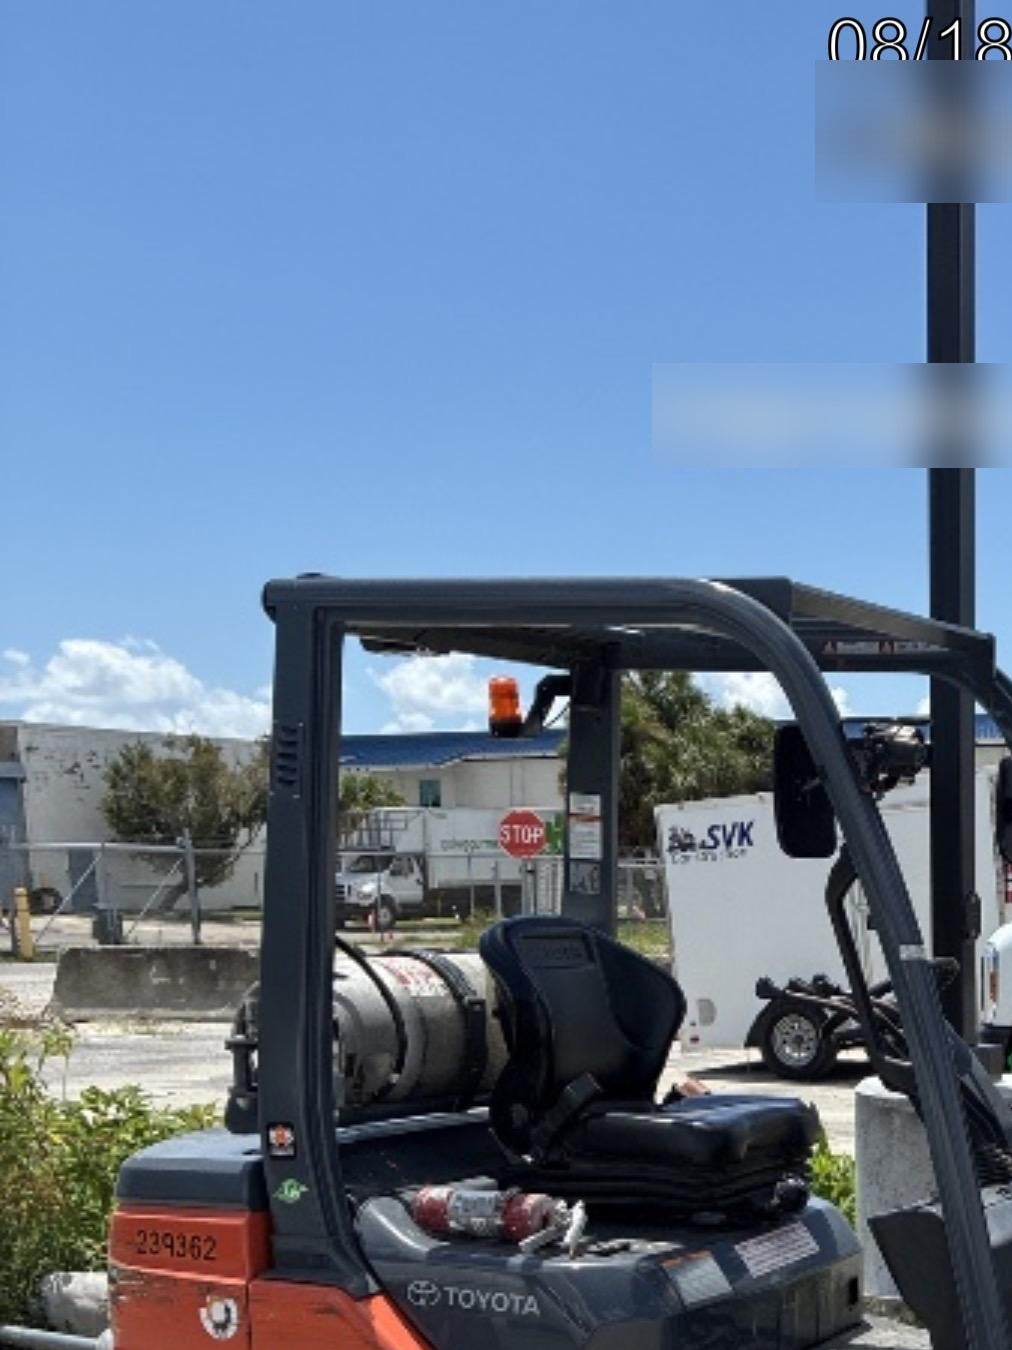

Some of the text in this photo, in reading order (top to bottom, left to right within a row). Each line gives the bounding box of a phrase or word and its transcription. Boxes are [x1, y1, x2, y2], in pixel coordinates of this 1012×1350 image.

[500, 824, 544, 845] STOP
[705, 821, 754, 850] SVK
[136, 1229, 217, 1261] 239362
[443, 1285, 540, 1316] TOYOTA
